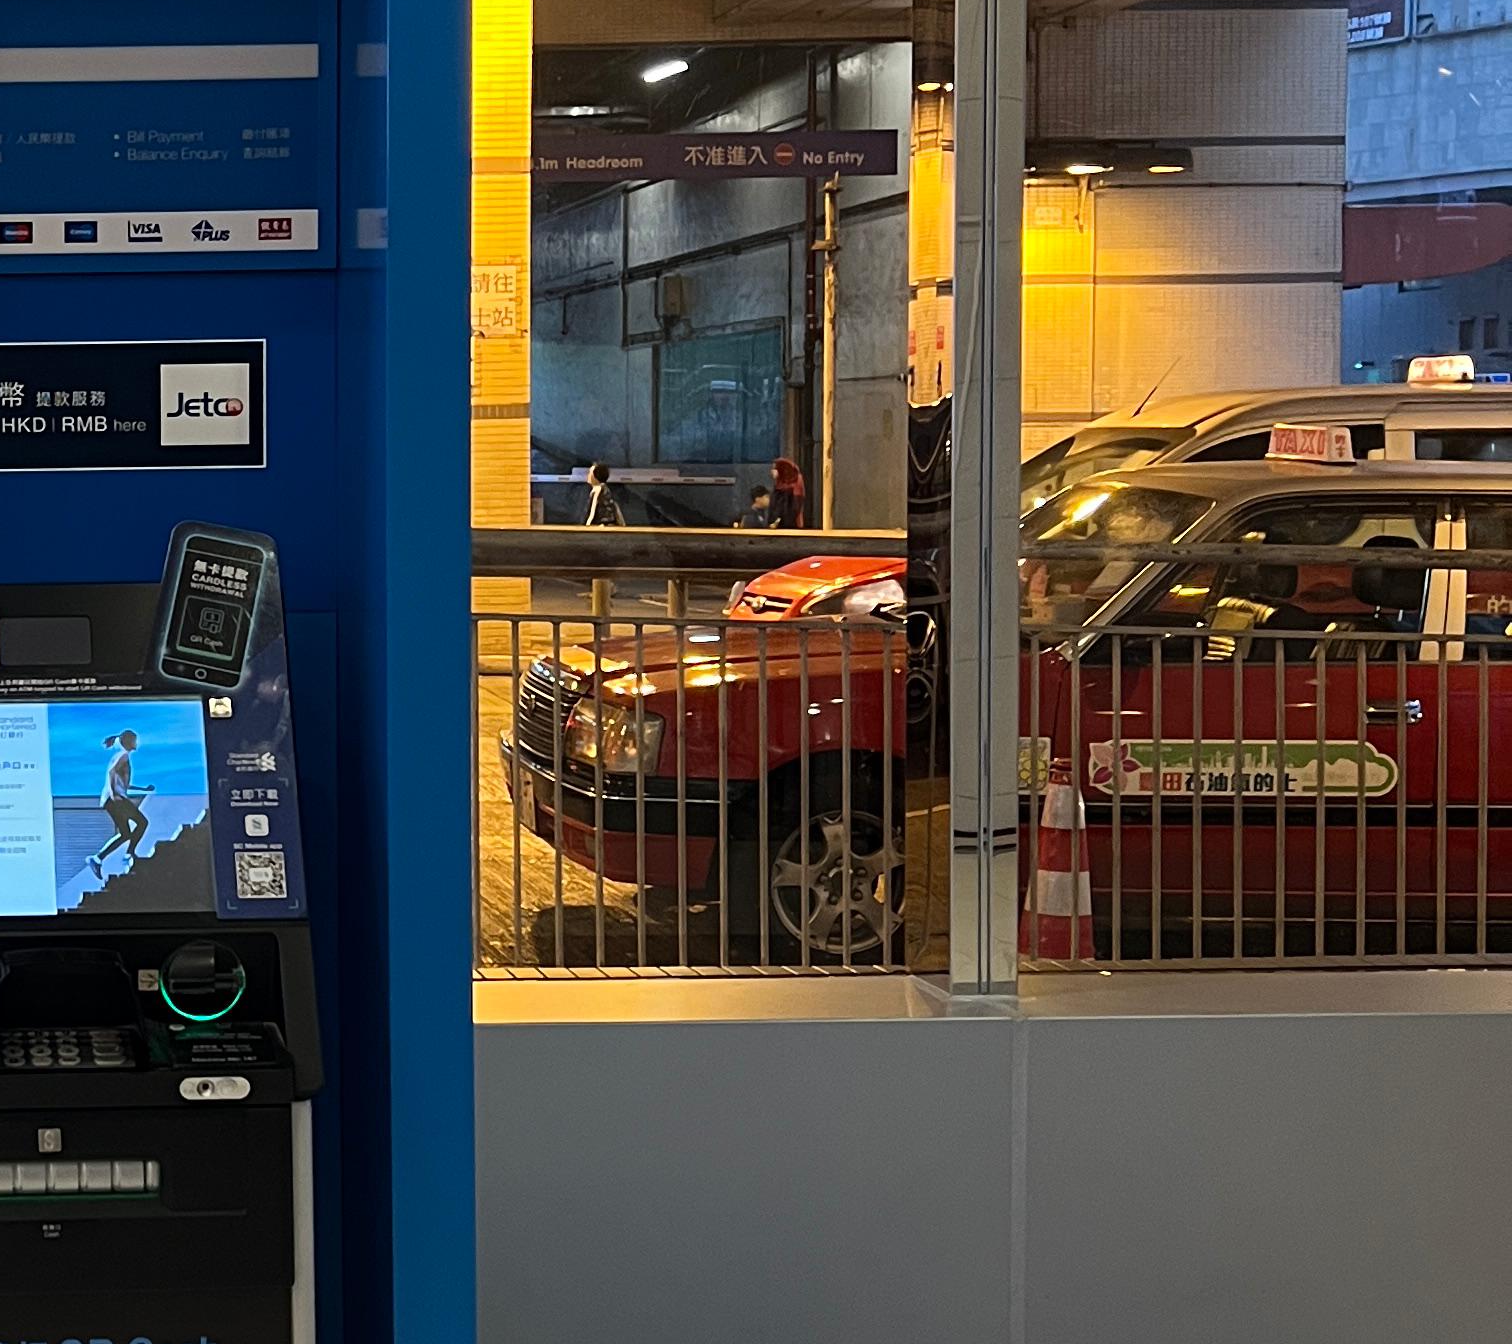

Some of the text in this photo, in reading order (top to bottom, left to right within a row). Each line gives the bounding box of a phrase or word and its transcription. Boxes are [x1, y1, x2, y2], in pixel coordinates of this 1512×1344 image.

[148, 129, 204, 145] Payment
[566, 156, 644, 170] Headroom
[683, 144, 866, 167] 不准進入 No Entry
[132, 222, 161, 235] VISA
[201, 228, 231, 242] PLUS
[1, 417, 47, 434] HKD
[61, 415, 109, 433] RMB
[113, 417, 147, 433] here
[1273, 429, 1326, 456] TAXI
[191, 573, 248, 592] CARDLESS
